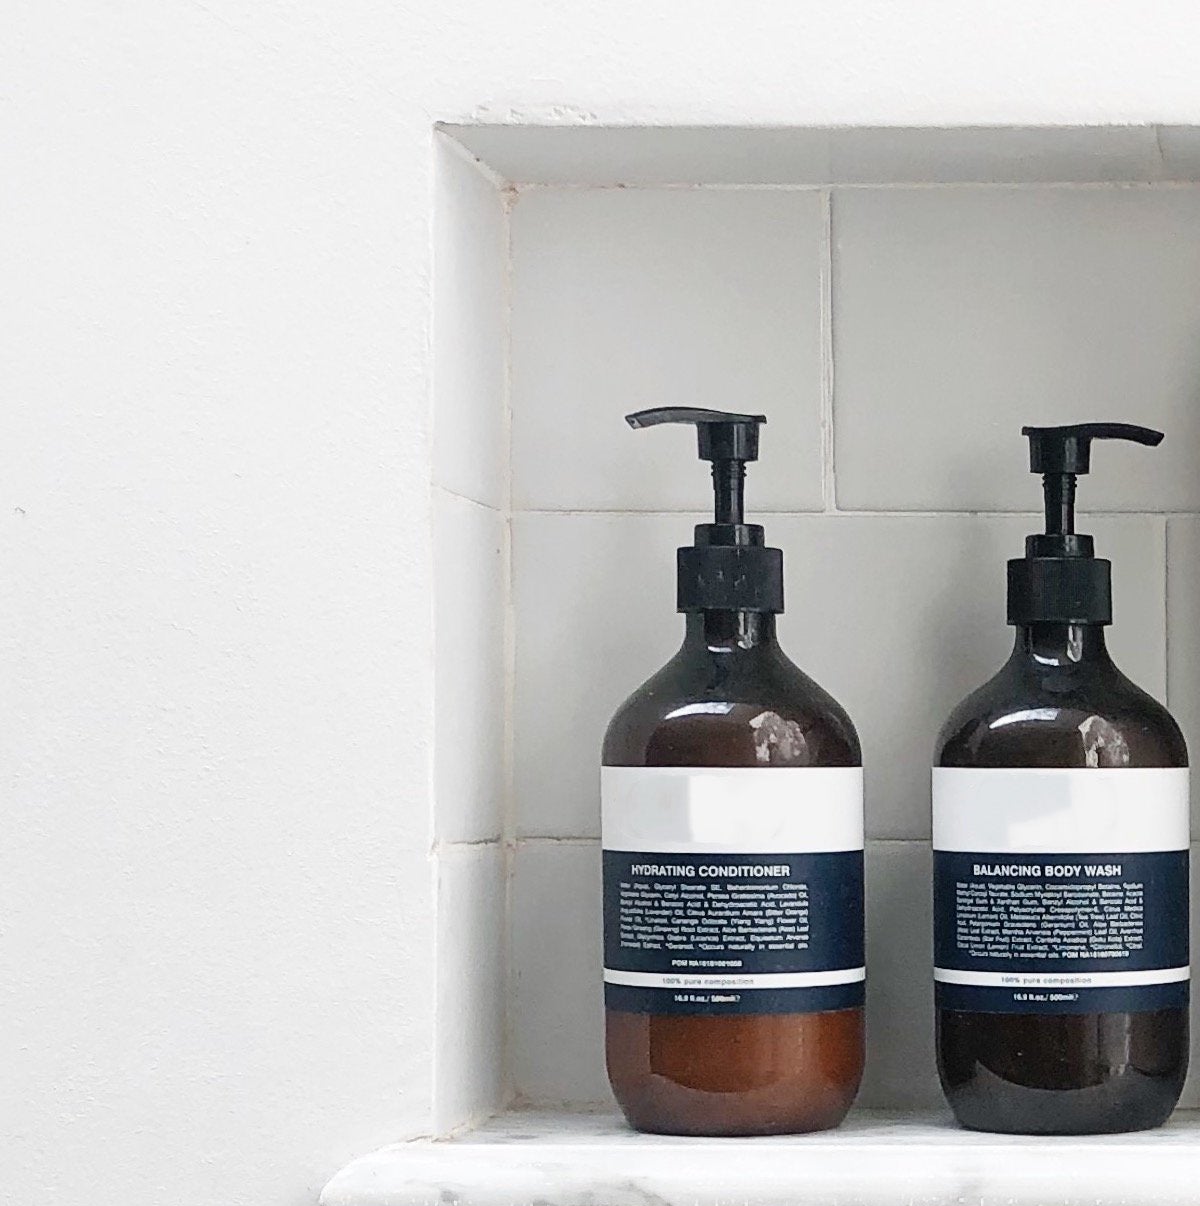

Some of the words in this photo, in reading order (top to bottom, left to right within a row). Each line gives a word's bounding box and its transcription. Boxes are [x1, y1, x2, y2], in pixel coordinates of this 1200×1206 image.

[631, 864, 695, 877] HYDRATING
[698, 865, 791, 877] CONDITIONER
[973, 864, 1041, 877] BALANCING
[1045, 865, 1081, 877] BODY
[1084, 864, 1122, 877] WASH
[684, 979, 702, 987] pure
[1023, 977, 1040, 986] pure
[1043, 976, 1092, 986] composition
